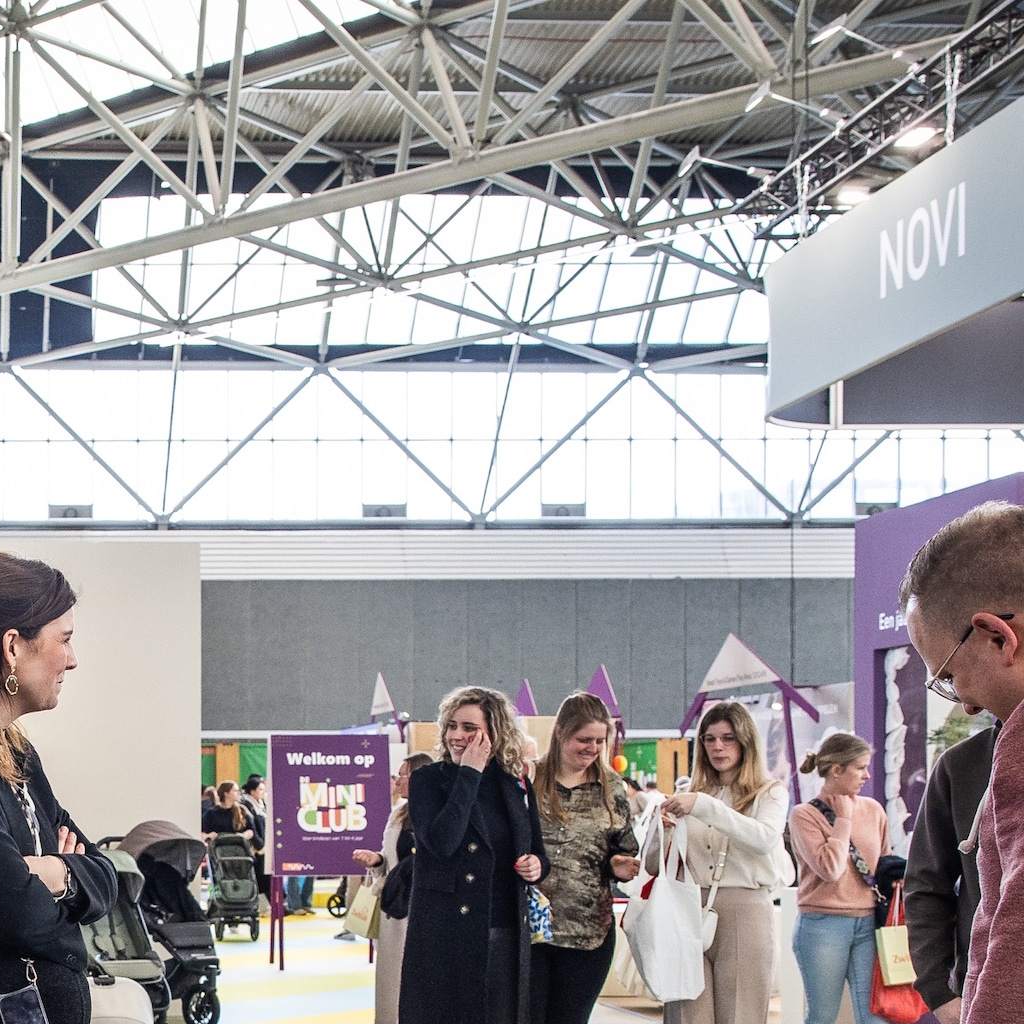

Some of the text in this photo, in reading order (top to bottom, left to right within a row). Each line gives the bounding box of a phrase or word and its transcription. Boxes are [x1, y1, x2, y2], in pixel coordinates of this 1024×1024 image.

[879, 181, 966, 299] NOVI
[286, 752, 375, 768] Welkom op
[297, 804, 368, 833] CLUB
